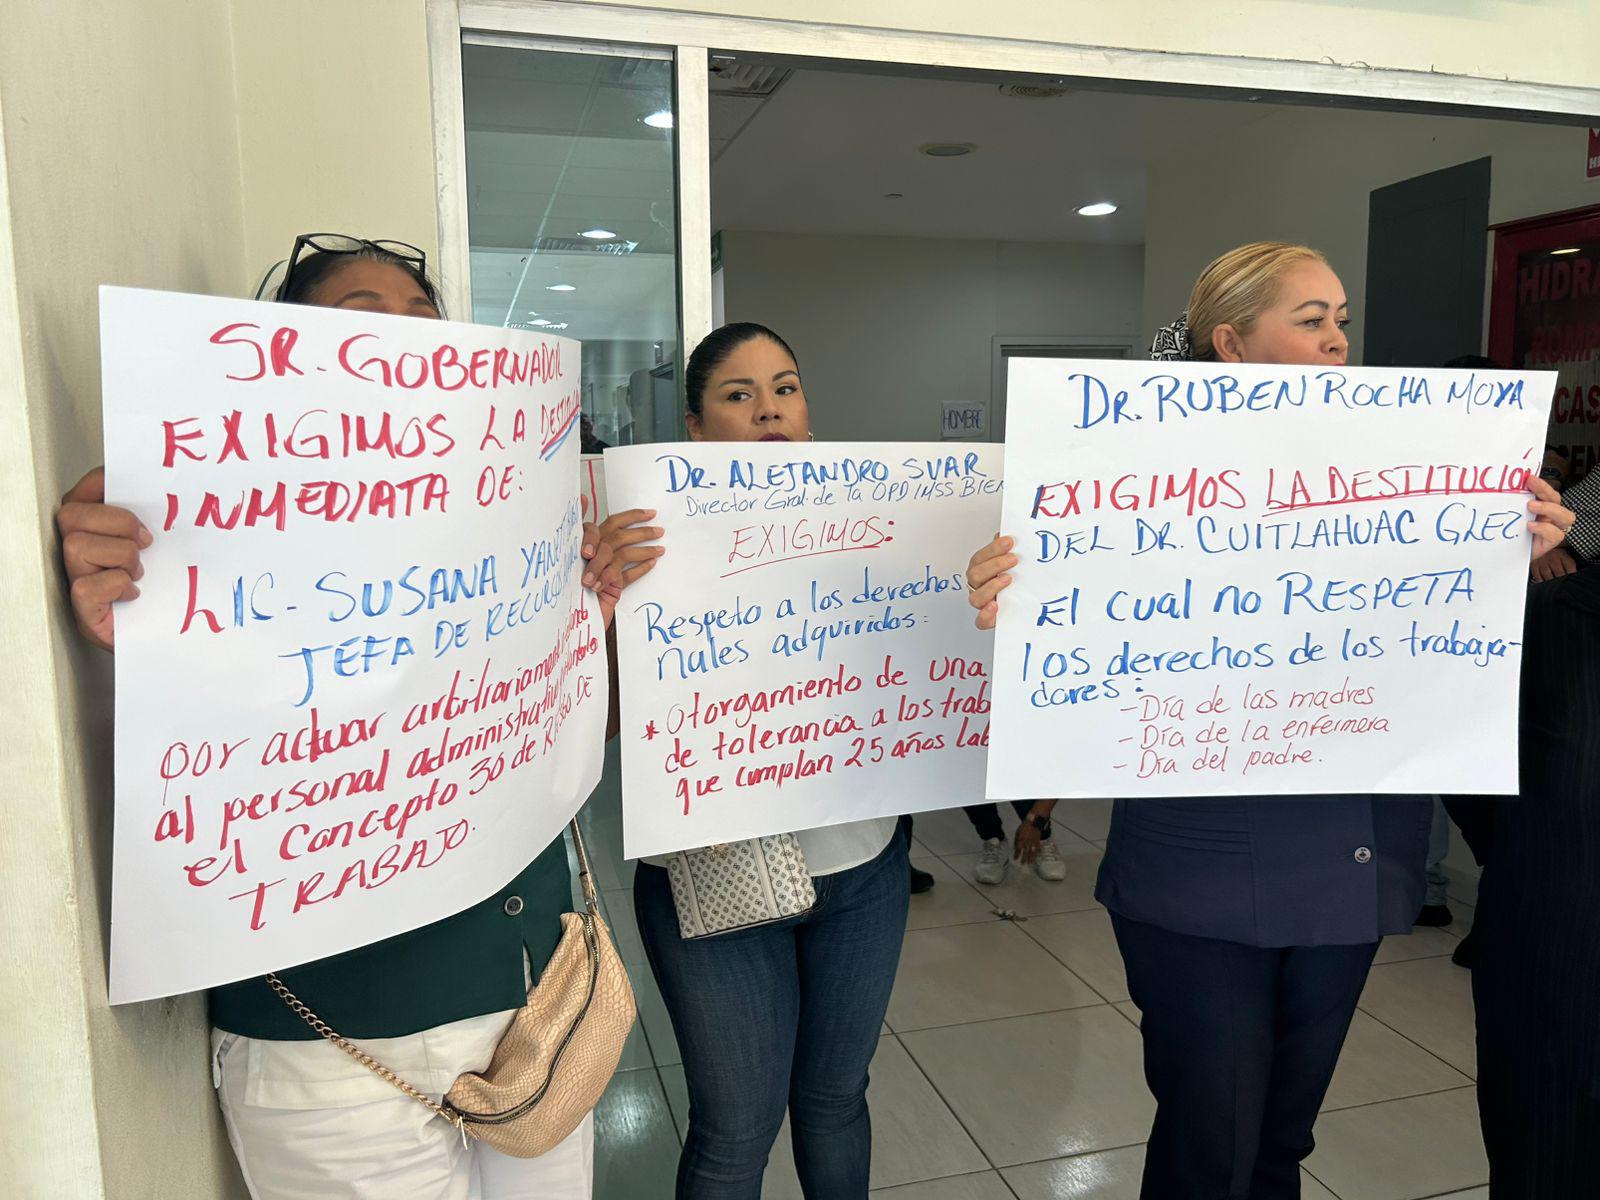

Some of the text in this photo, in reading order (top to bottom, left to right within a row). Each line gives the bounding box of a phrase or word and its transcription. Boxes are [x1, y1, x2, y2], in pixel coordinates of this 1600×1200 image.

[337, 333, 561, 392] GOBERNADOR
[1142, 374, 1308, 414] RUBEN
[1316, 372, 1431, 409] ROCHA
[161, 409, 456, 469] EXIGIMOS
[479, 405, 527, 452] LA
[162, 471, 449, 532] INMEDIATA
[686, 493, 757, 517] Director
[813, 485, 836, 506] de
[728, 458, 890, 492] ALEJANDRO
[1030, 466, 1248, 520] EXIGIMOS
[1266, 468, 1312, 507] LA
[728, 515, 896, 564] EXIGIMOS:
[1035, 525, 1114, 565] DEL
[1195, 508, 1420, 555] CUITLAHUAC
[314, 555, 499, 624] SUSANA
[634, 564, 963, 646] Respeto a los derechos
[1105, 578, 1193, 622] cual
[1212, 584, 1263, 616] no
[1276, 566, 1474, 617] RESPETA
[279, 634, 416, 707] JEFA
[434, 619, 469, 658] DE
[657, 640, 749, 681] nales
[875, 655, 909, 689] de
[929, 656, 985, 683] una
[1022, 641, 1092, 683] los
[1105, 635, 1276, 677] derechos
[1287, 631, 1325, 667] de
[1339, 627, 1385, 663] los
[260, 708, 384, 767] actuar
[401, 626, 561, 734] arbitrariament
[1196, 685, 1231, 713] de
[1243, 682, 1278, 709] las
[1289, 676, 1376, 709] madres
[664, 737, 698, 773] de
[711, 715, 859, 761] tolerancia
[870, 708, 889, 727] a
[897, 695, 933, 722] los
[1191, 747, 1227, 772] del
[1195, 720, 1231, 744] de
[1241, 719, 1271, 742] la
[153, 794, 196, 845] al
[221, 749, 391, 851] personal
[675, 776, 723, 815] que
[735, 749, 834, 788] cumplan
[844, 737, 885, 768] 25
[889, 730, 946, 759] años
[183, 837, 248, 889] el
[511, 735, 537, 770] de
